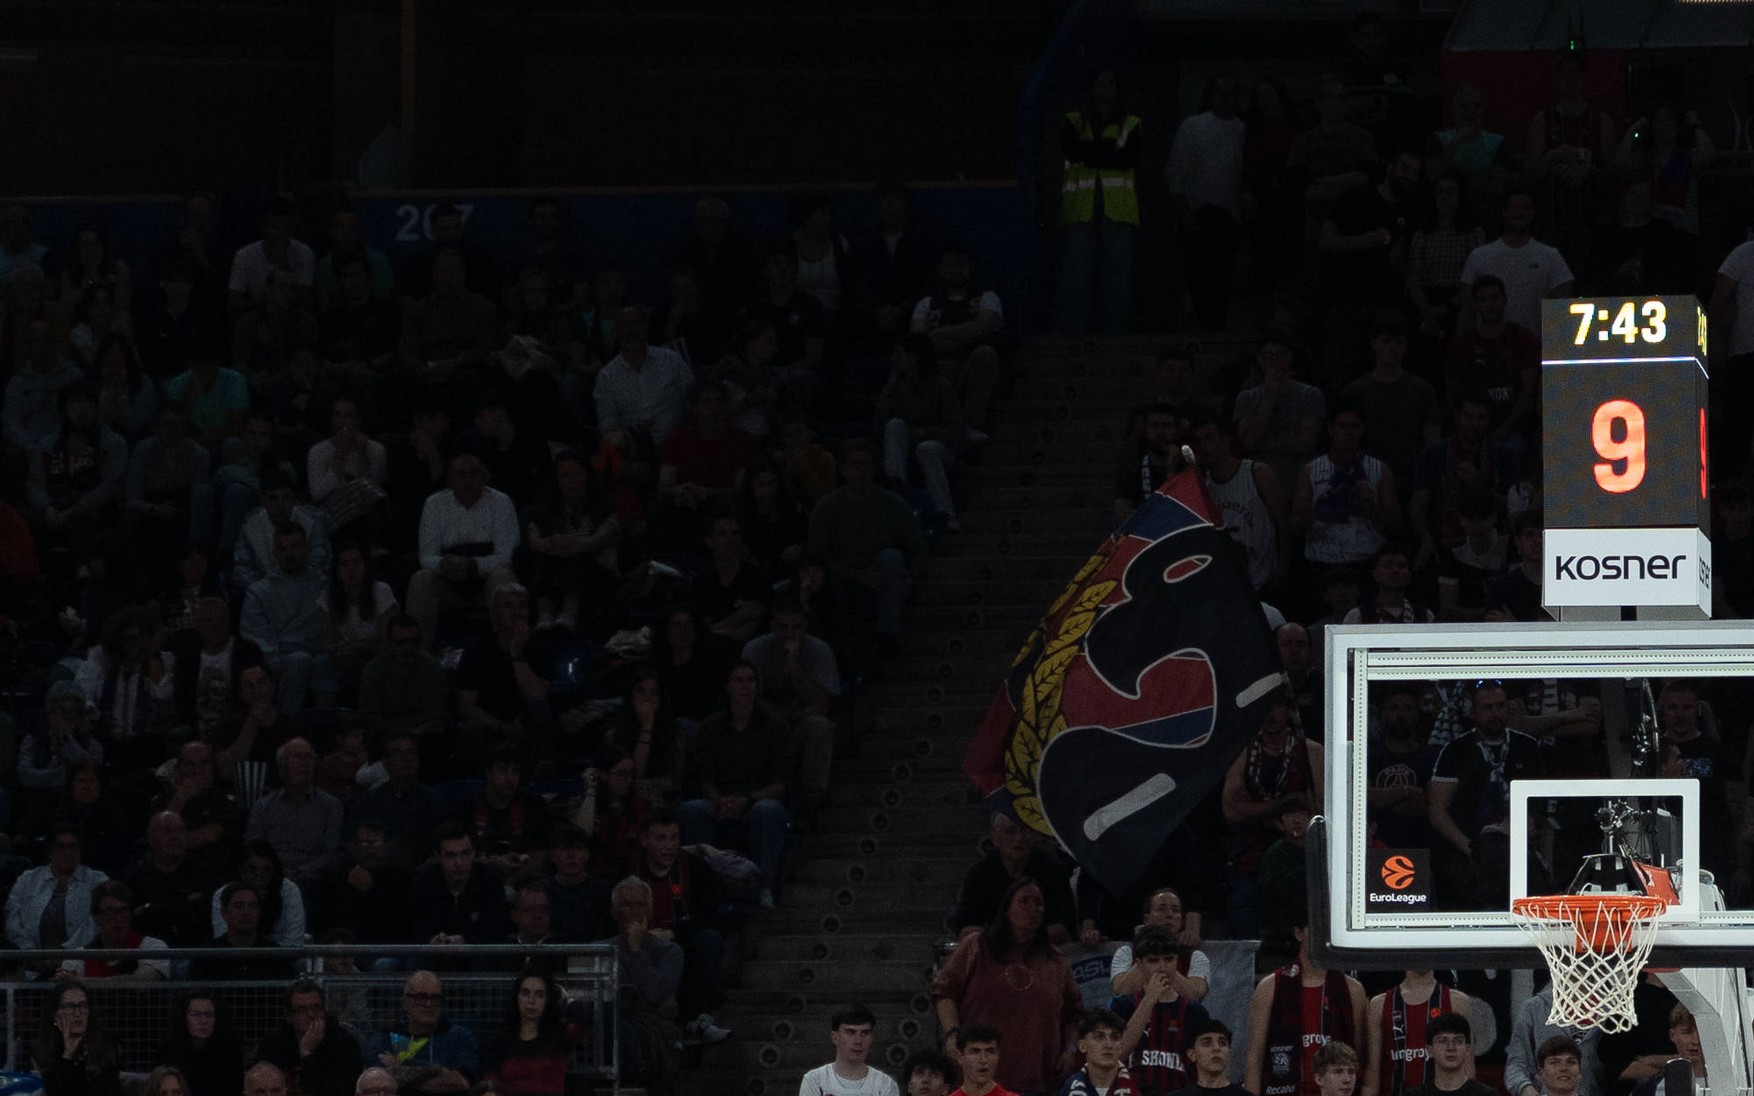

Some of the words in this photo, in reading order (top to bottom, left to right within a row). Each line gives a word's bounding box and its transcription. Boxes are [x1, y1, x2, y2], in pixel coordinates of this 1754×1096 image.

[1569, 300, 1667, 346] 7:43
[1591, 399, 1647, 495] 9
[1369, 892, 1427, 905] EuroLeague
